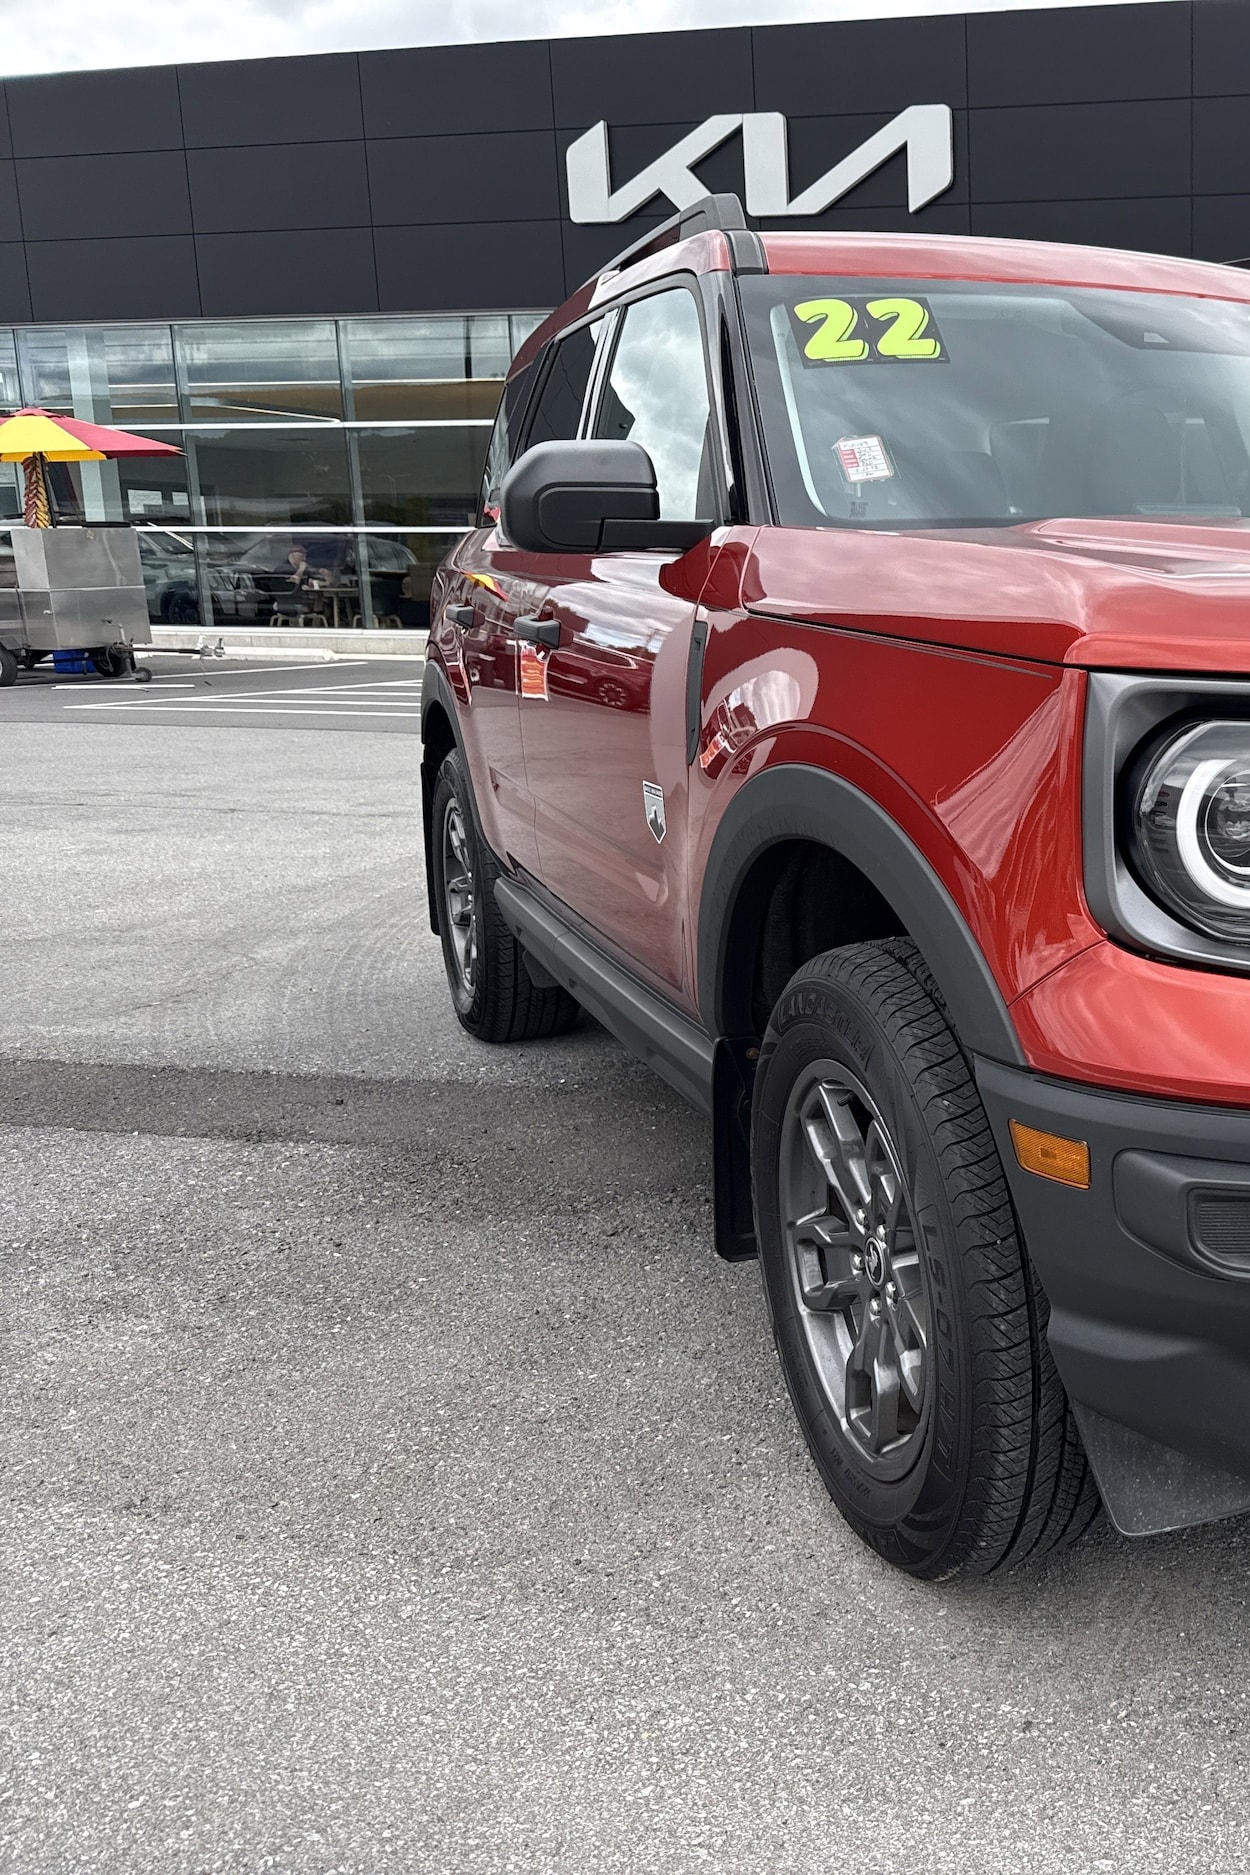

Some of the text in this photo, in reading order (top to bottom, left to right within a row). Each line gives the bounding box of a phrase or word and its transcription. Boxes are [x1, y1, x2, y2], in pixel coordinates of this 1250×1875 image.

[566, 104, 953, 223] KIA
[793, 298, 940, 362] 22
[780, 991, 870, 1062] LANCASTER
